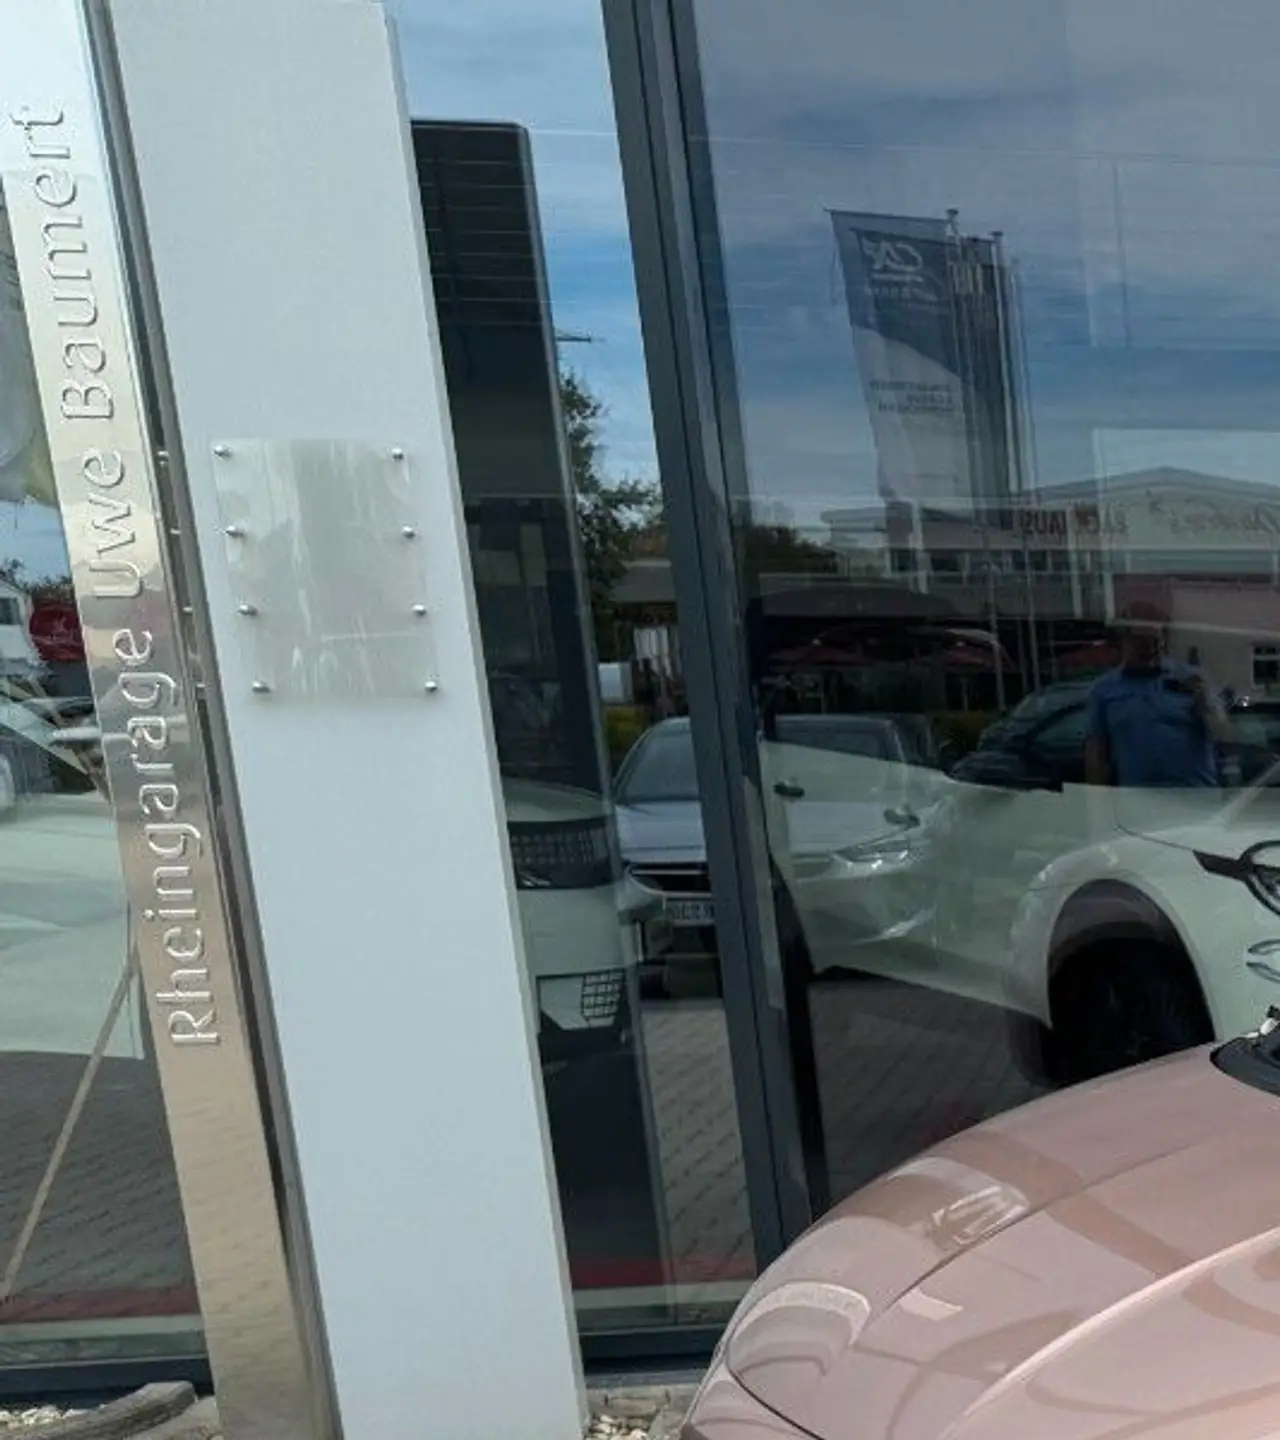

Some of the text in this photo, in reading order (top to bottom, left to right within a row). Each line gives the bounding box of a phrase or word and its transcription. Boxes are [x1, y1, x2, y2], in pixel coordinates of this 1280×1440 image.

[8, 103, 220, 1045] Rheingarage Uwe Baumert
